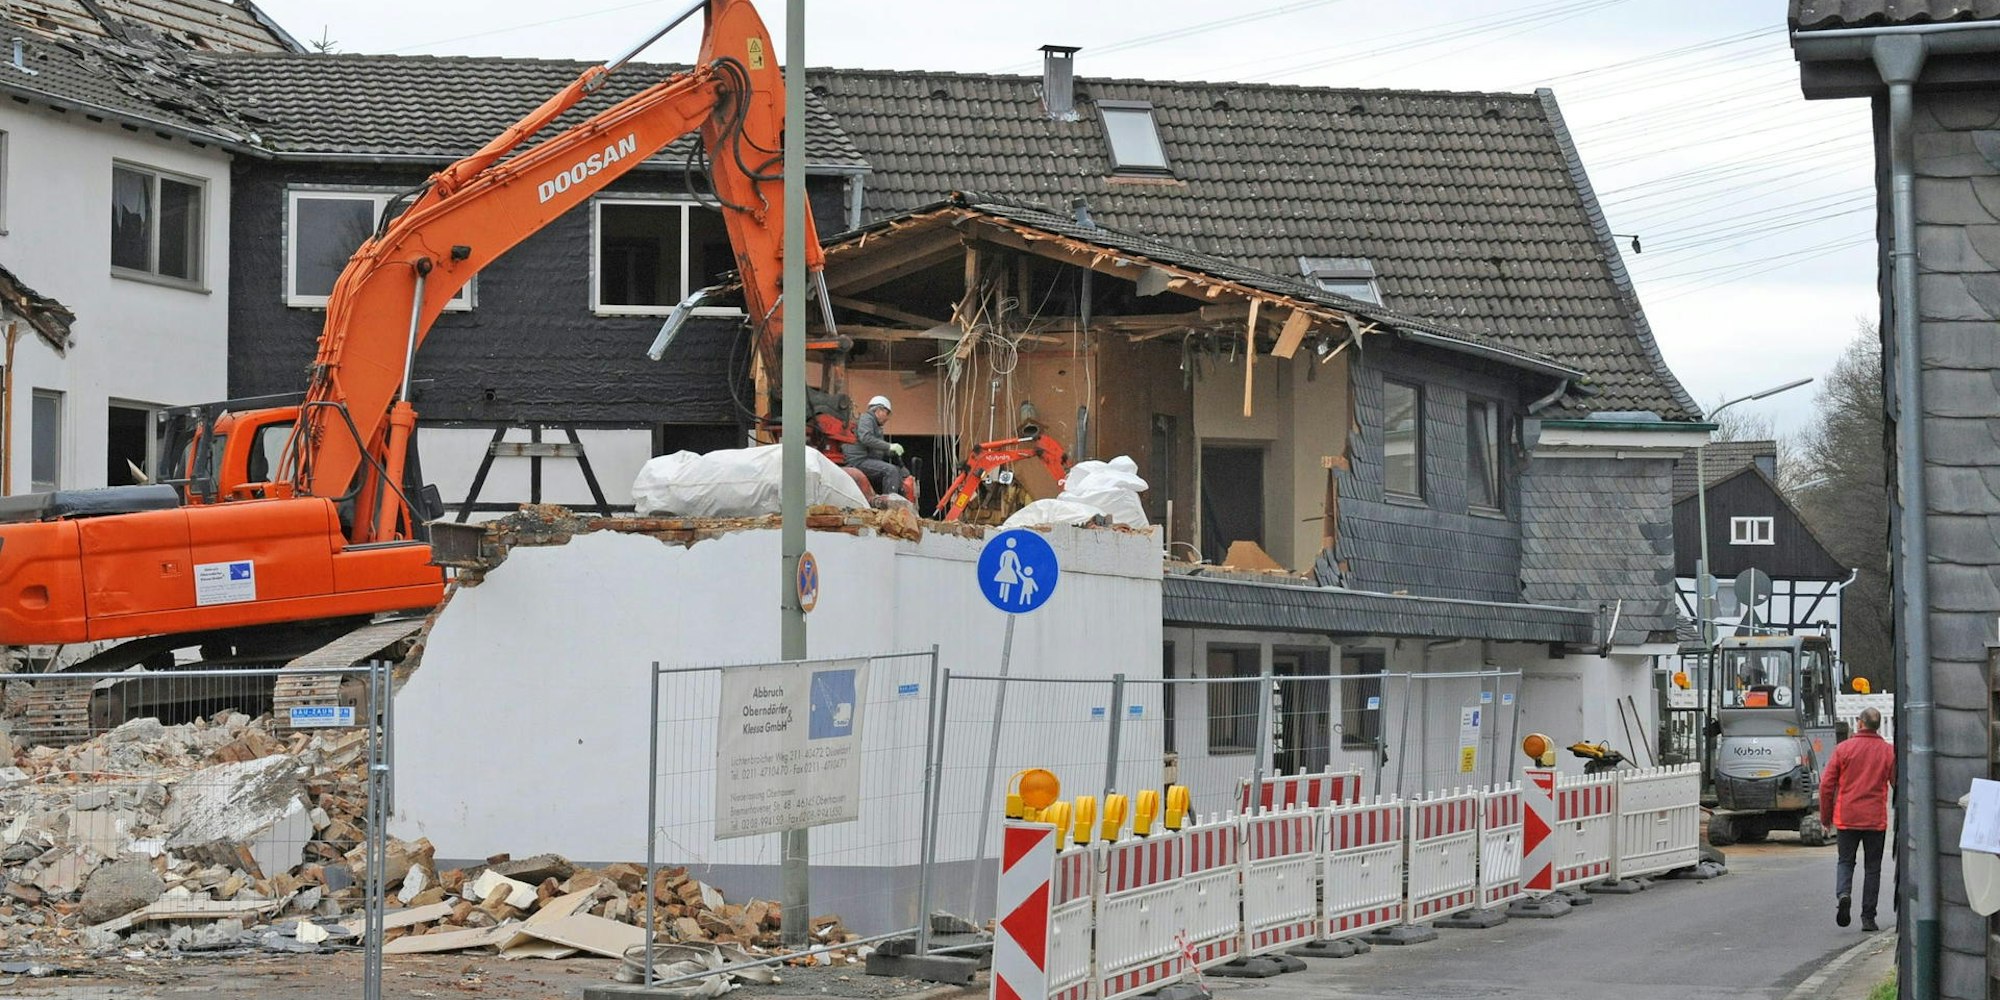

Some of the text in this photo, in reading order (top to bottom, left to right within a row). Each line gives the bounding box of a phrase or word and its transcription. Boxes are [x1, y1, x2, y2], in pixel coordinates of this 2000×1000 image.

[538, 133, 637, 204] DOOSAN
[752, 686, 784, 699] Abbruch
[742, 703, 789, 717] Oberndörfer
[786, 709, 793, 723] &
[742, 720, 787, 735] Klessa GmbH
[1733, 746, 1772, 756] Kubota
